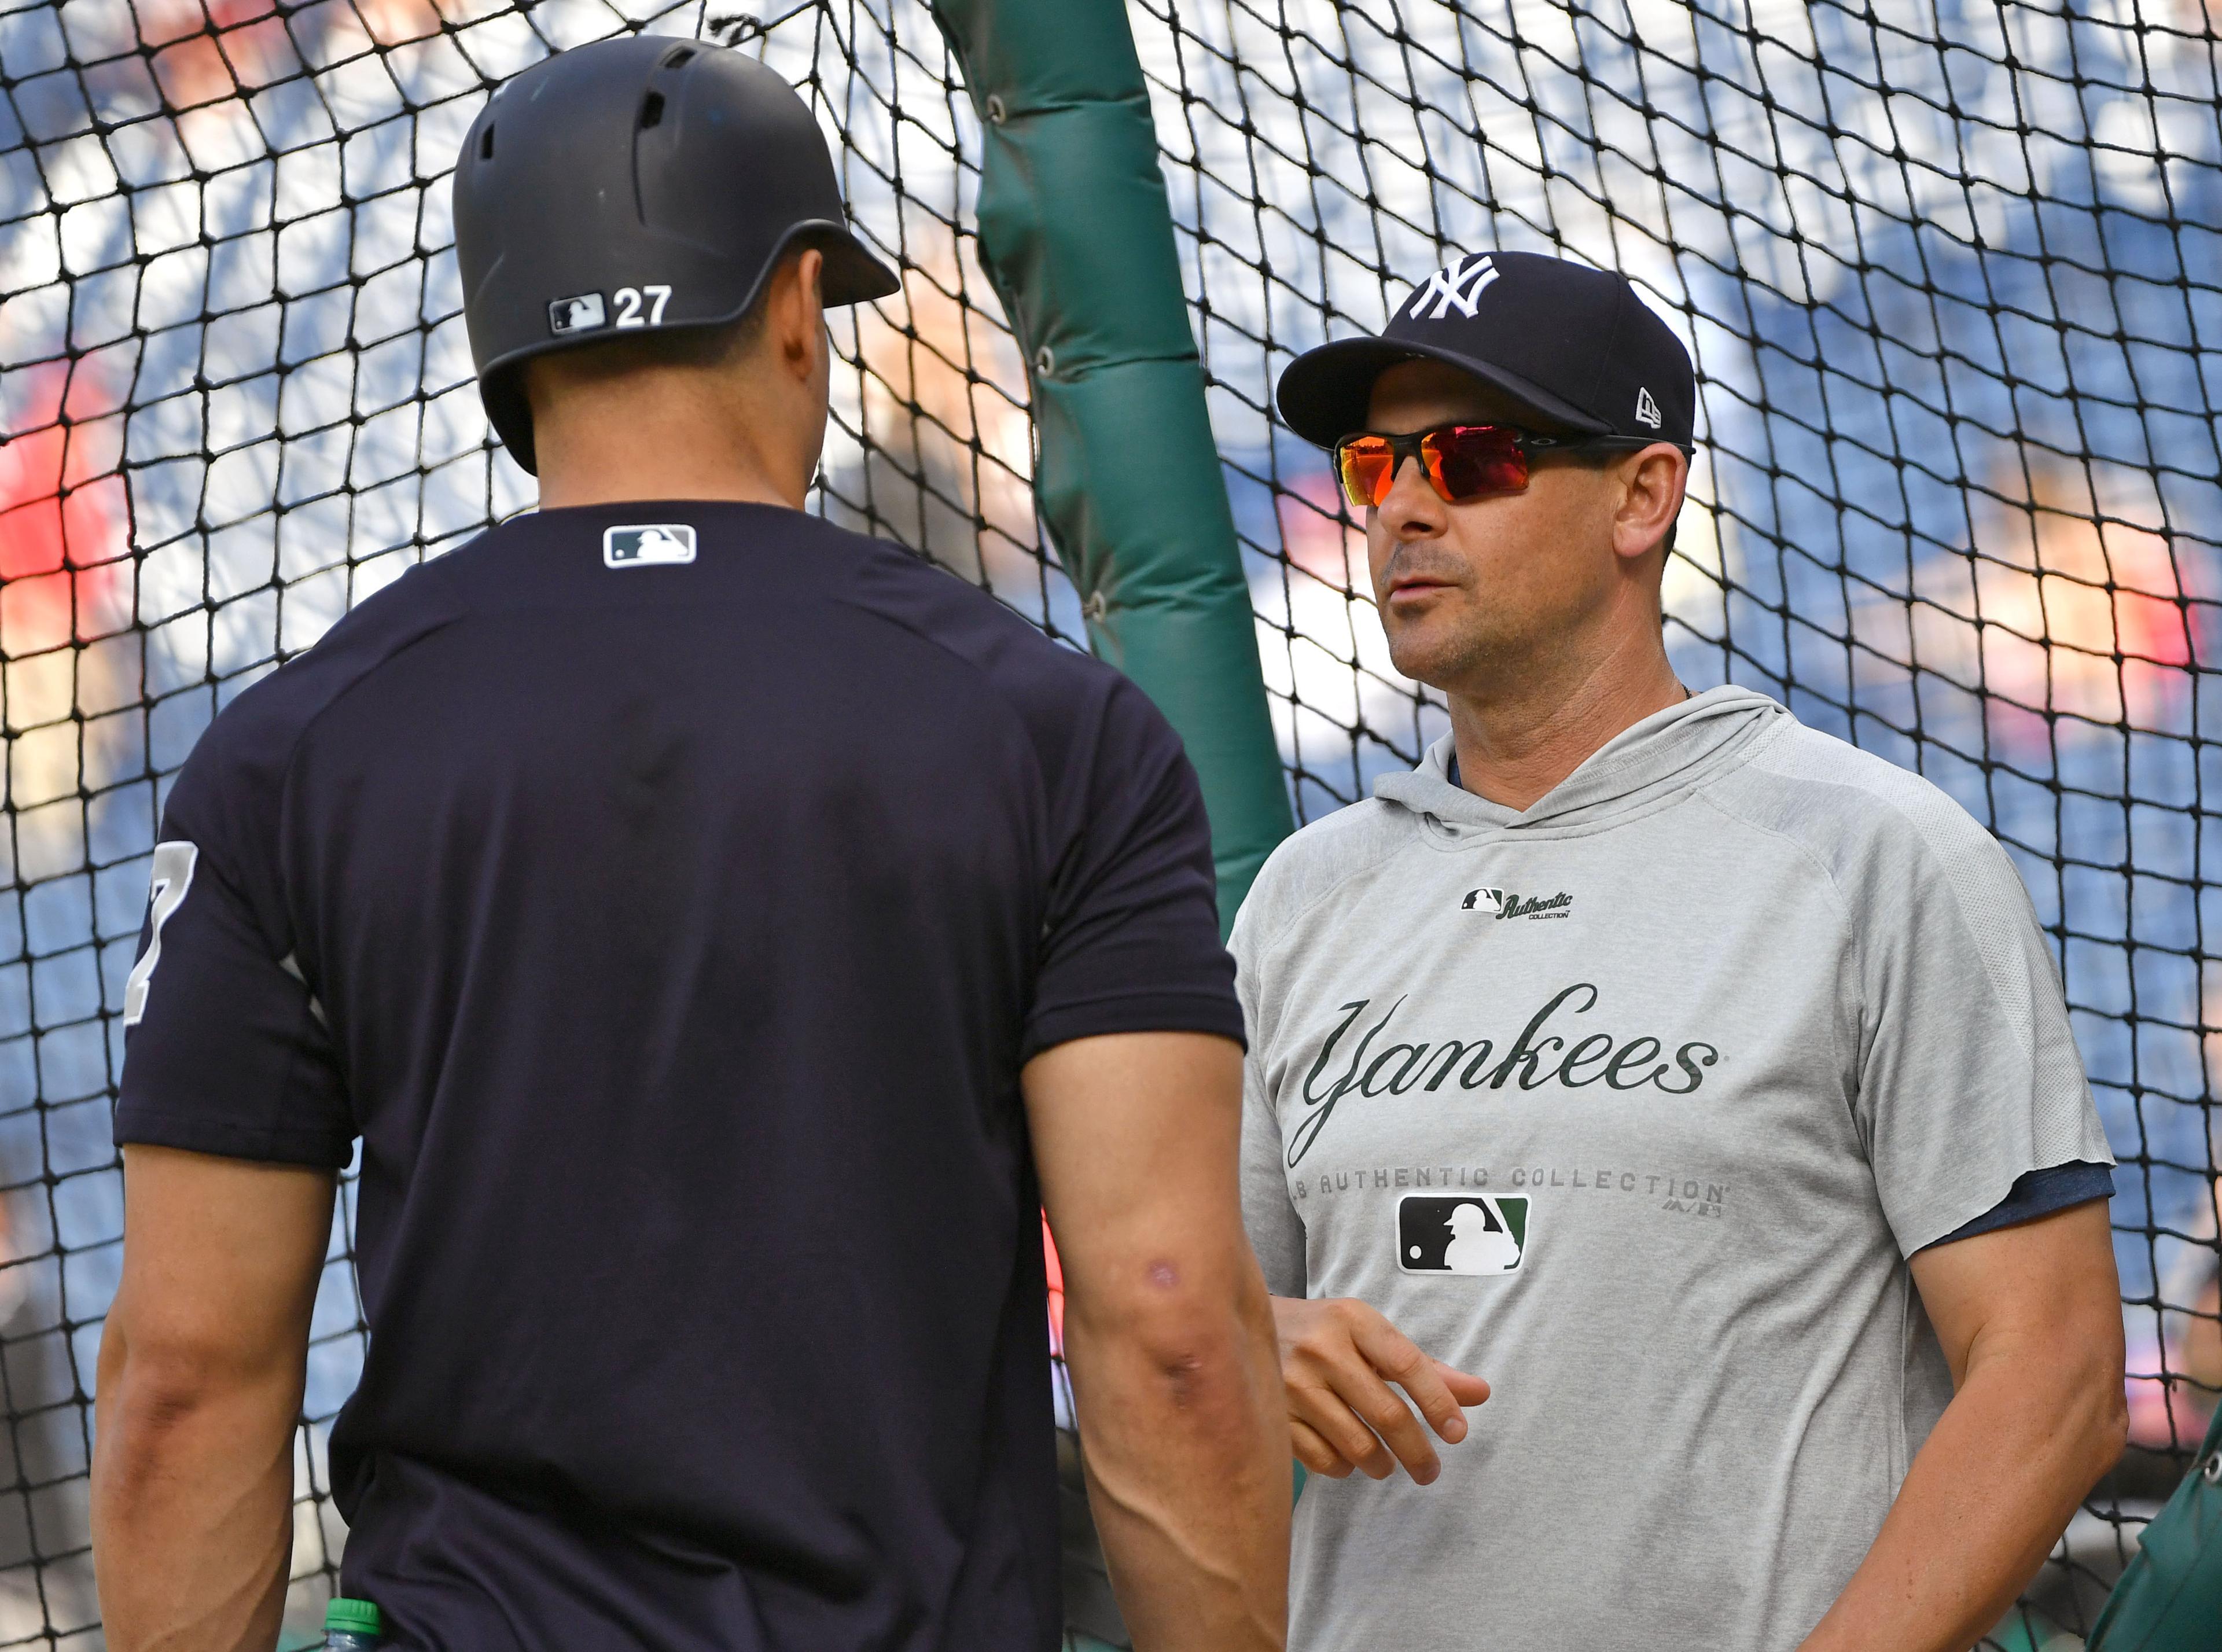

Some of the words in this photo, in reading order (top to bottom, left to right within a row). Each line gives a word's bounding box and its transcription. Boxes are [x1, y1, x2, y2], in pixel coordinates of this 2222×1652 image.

[613, 285, 672, 329] 27
[1495, 891, 1573, 919] Authentic
[1287, 983, 1719, 1169] Yankees
[1320, 1167, 1489, 1194] AUTHENTIC
[1512, 1168, 1724, 1204] COLLECTION
